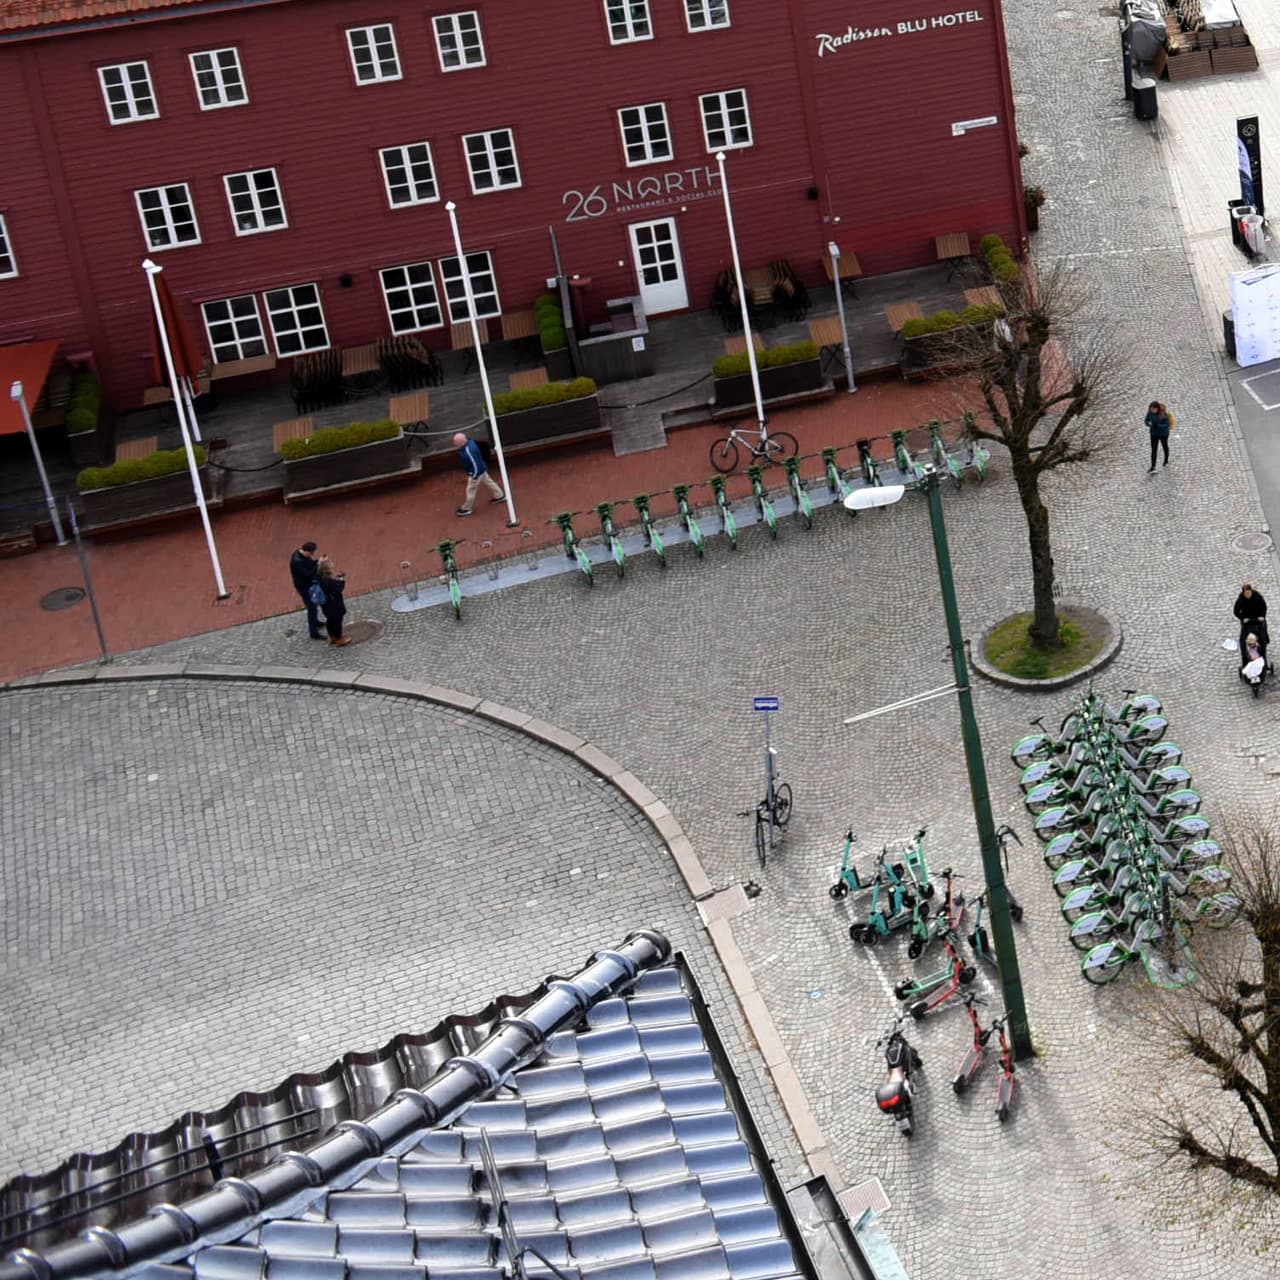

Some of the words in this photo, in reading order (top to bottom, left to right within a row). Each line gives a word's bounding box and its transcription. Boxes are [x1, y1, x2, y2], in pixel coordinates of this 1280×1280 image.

[815, 25, 893, 58] Radisson
[897, 18, 928, 34] BLU
[931, 9, 984, 30] HOTEL
[562, 185, 607, 222] 26
[612, 166, 722, 203] NORTH
